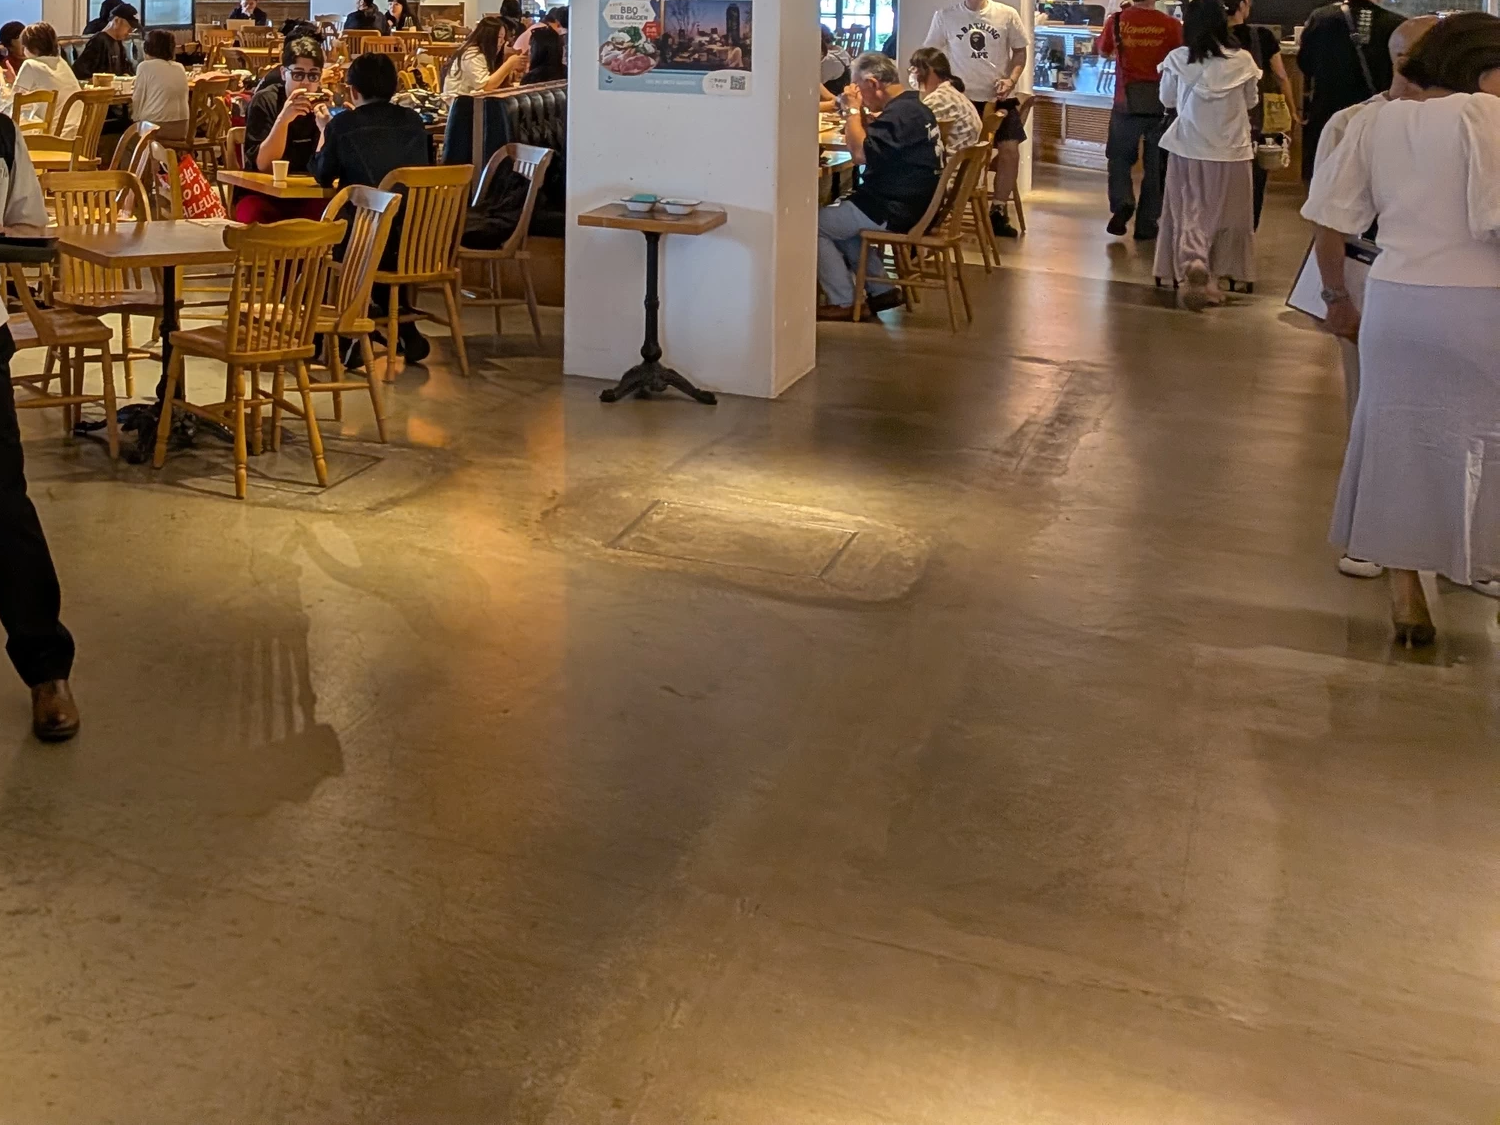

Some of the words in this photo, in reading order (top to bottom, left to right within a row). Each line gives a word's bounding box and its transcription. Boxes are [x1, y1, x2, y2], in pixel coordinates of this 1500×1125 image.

[620, 6, 638, 15] BBQ
[961, 23, 1000, 40] BATHING
[971, 51, 989, 59] APE
